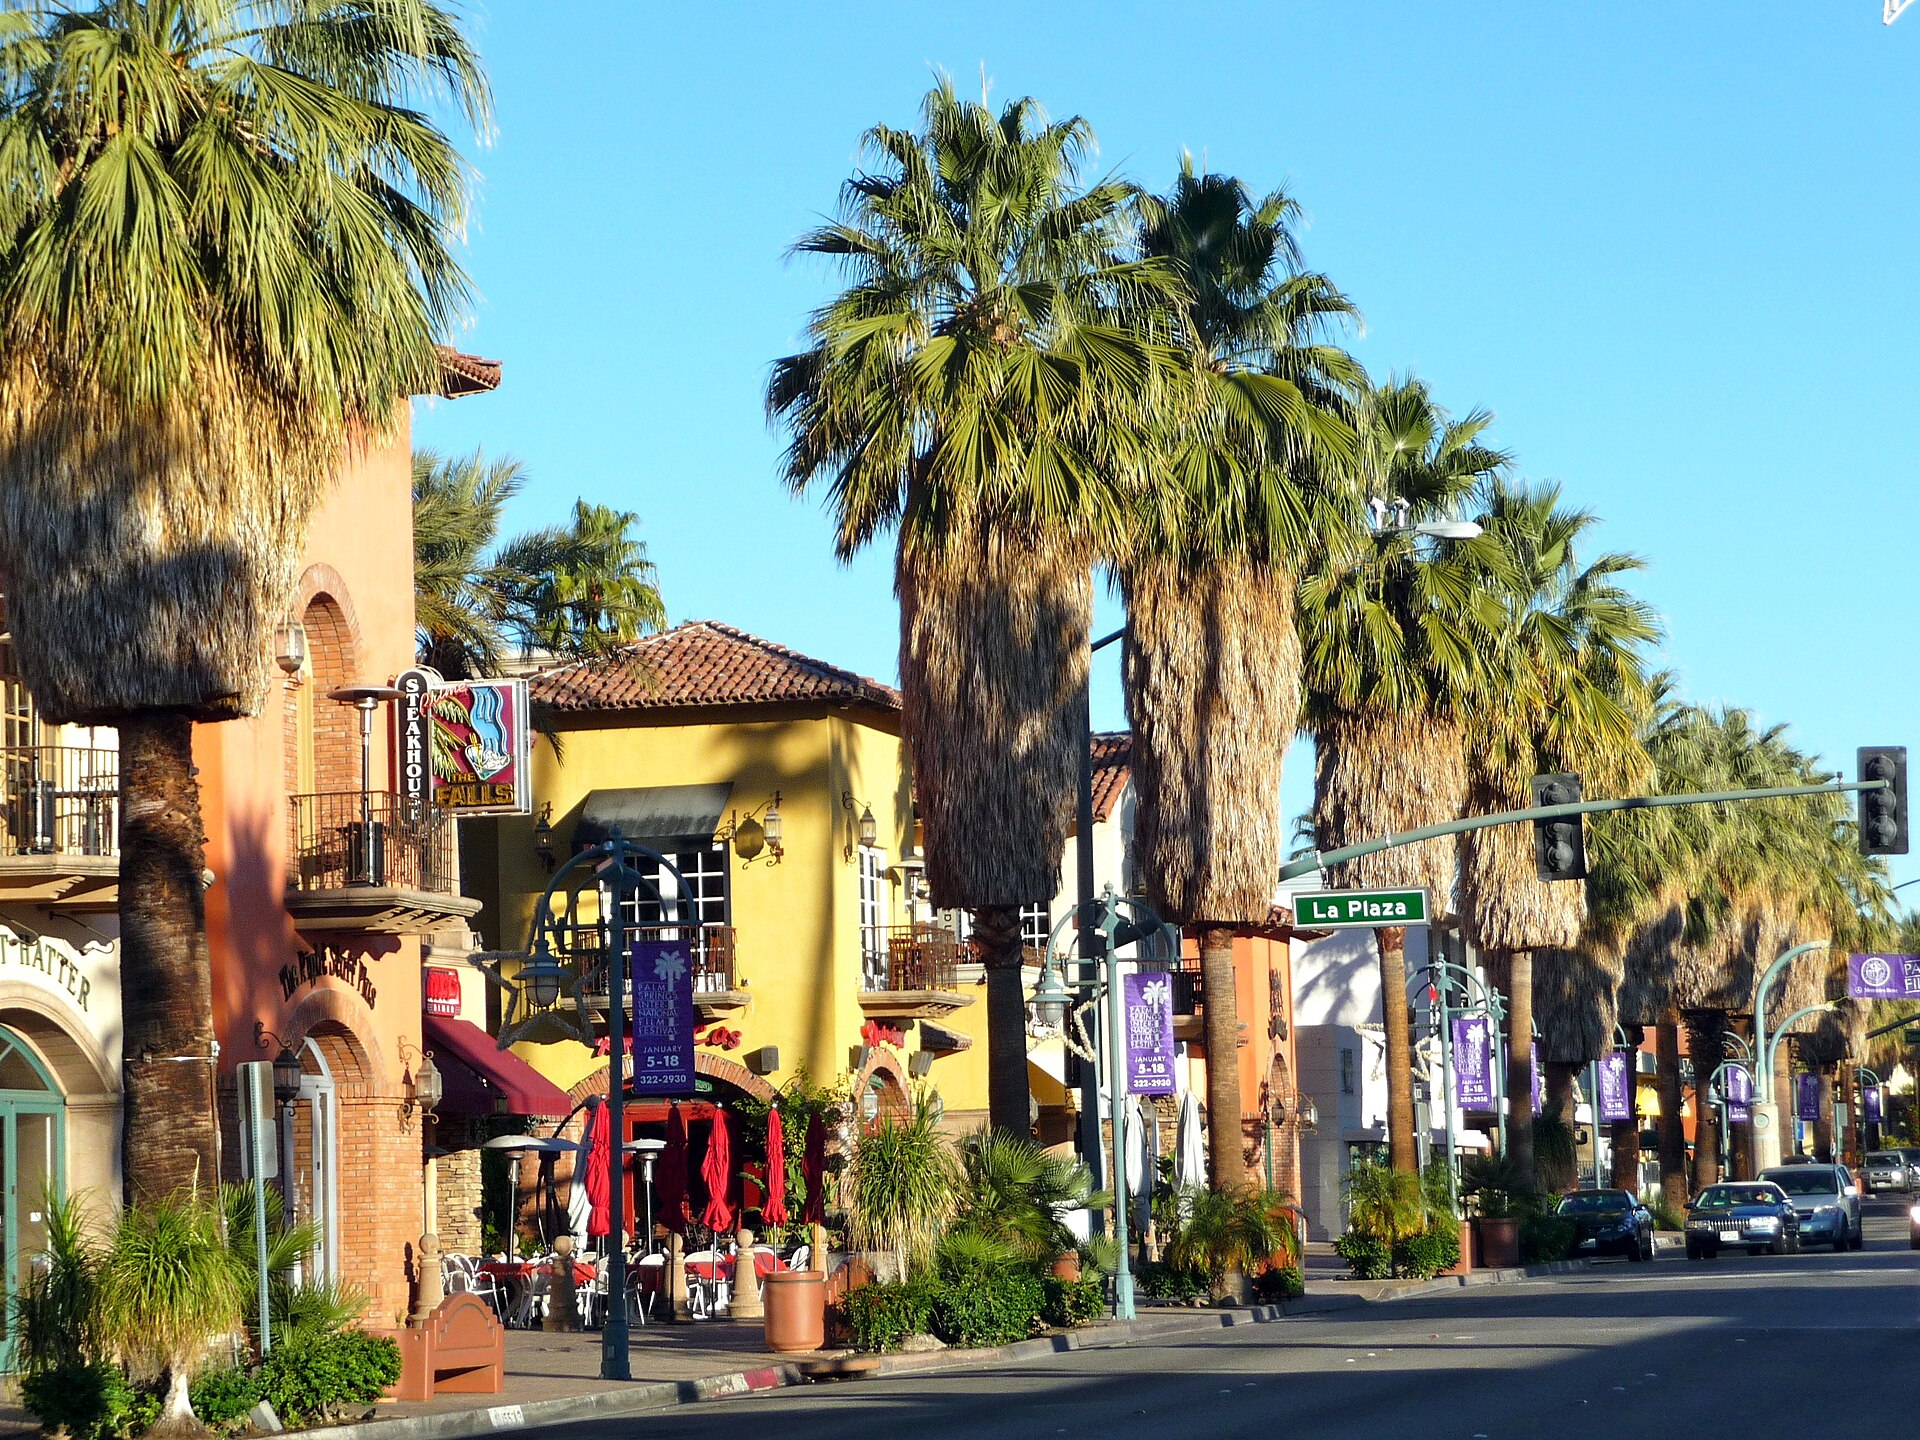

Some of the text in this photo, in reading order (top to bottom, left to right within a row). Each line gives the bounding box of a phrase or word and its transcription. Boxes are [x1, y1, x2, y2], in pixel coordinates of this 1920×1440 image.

[419, 683, 469, 718] Prime
[451, 772, 477, 783] THE
[437, 783, 514, 805] FALLS
[1312, 900, 1407, 919] La Plaza
[19, 934, 91, 1012] HATTER
[638, 983, 666, 991] PALM
[638, 991, 679, 1000] SPRINGS
[638, 1009, 679, 1017] NATIONAL
[638, 1018, 665, 1026] FILM
[638, 1027, 678, 1035] FESTIVAL
[646, 1055, 680, 1068] 5-18
[1138, 1063, 1165, 1074] 5-18
[640, 1075, 687, 1084] 322-2930
[1133, 1079, 1171, 1088] 322-2930
